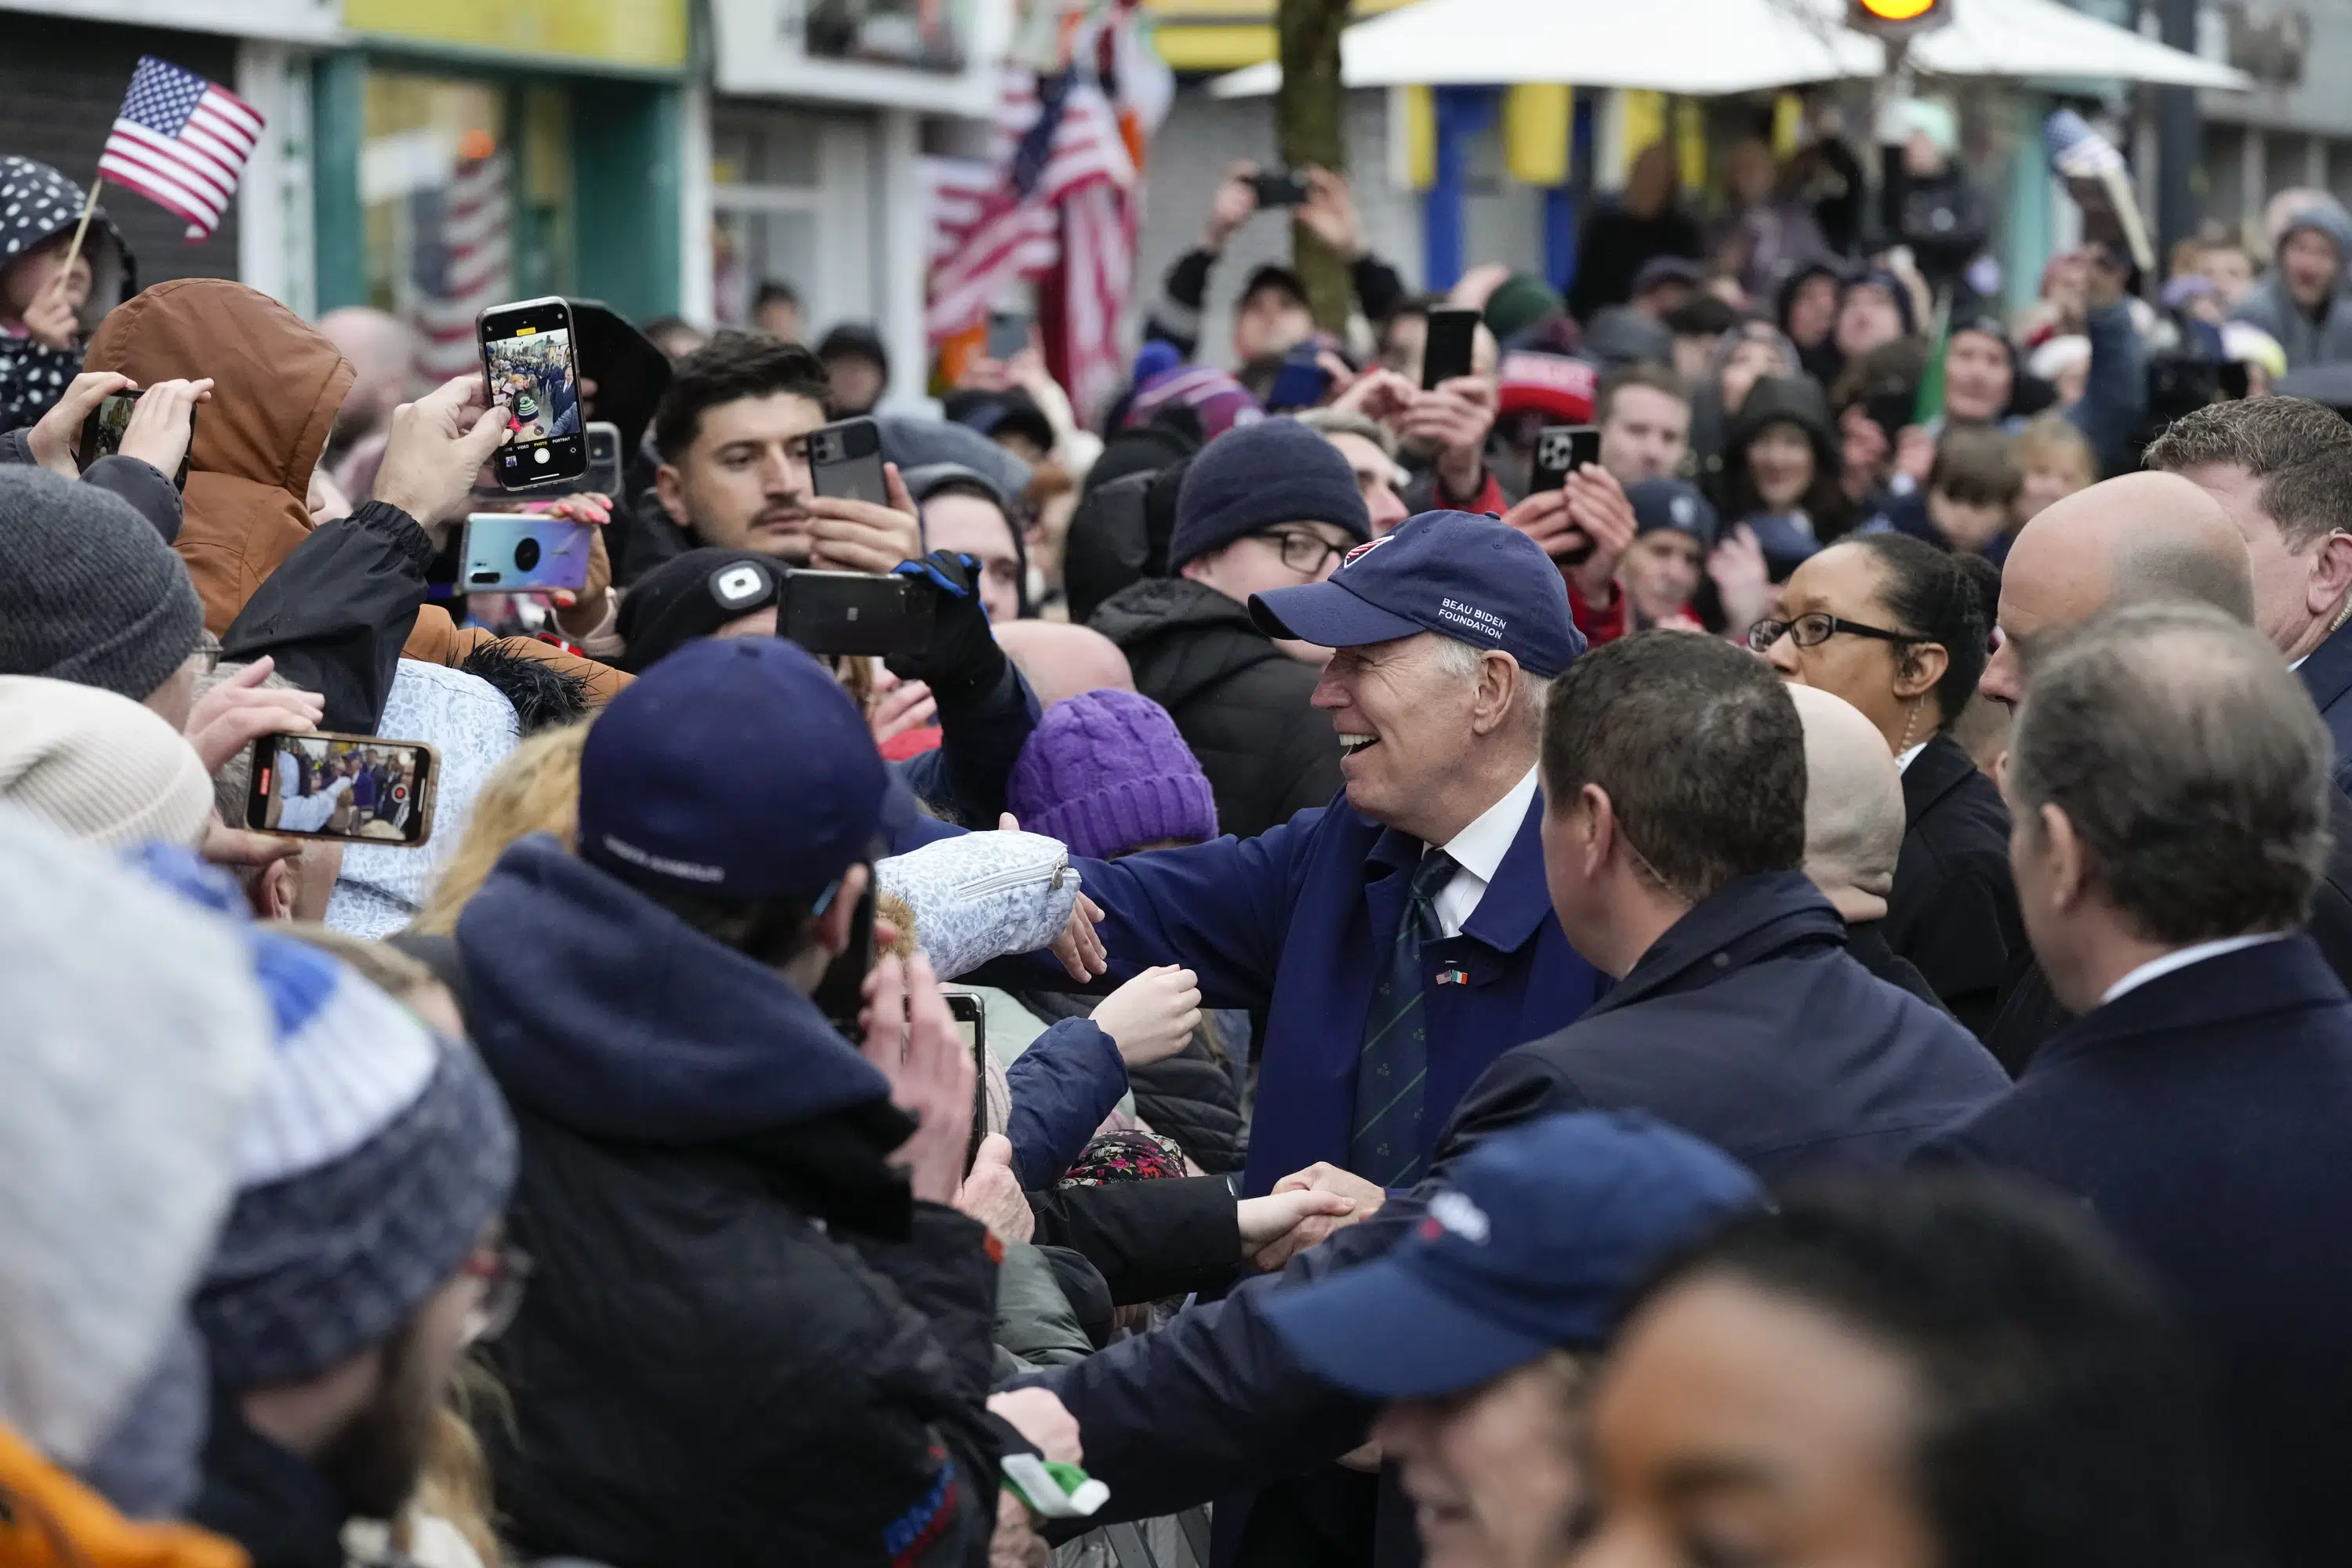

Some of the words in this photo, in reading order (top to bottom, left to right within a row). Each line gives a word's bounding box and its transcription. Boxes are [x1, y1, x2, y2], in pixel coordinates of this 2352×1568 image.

[1438, 608, 1503, 640] FOUNDATION
[1443, 597, 1473, 615] BEAU
[1474, 609, 1507, 629] BIDEN
